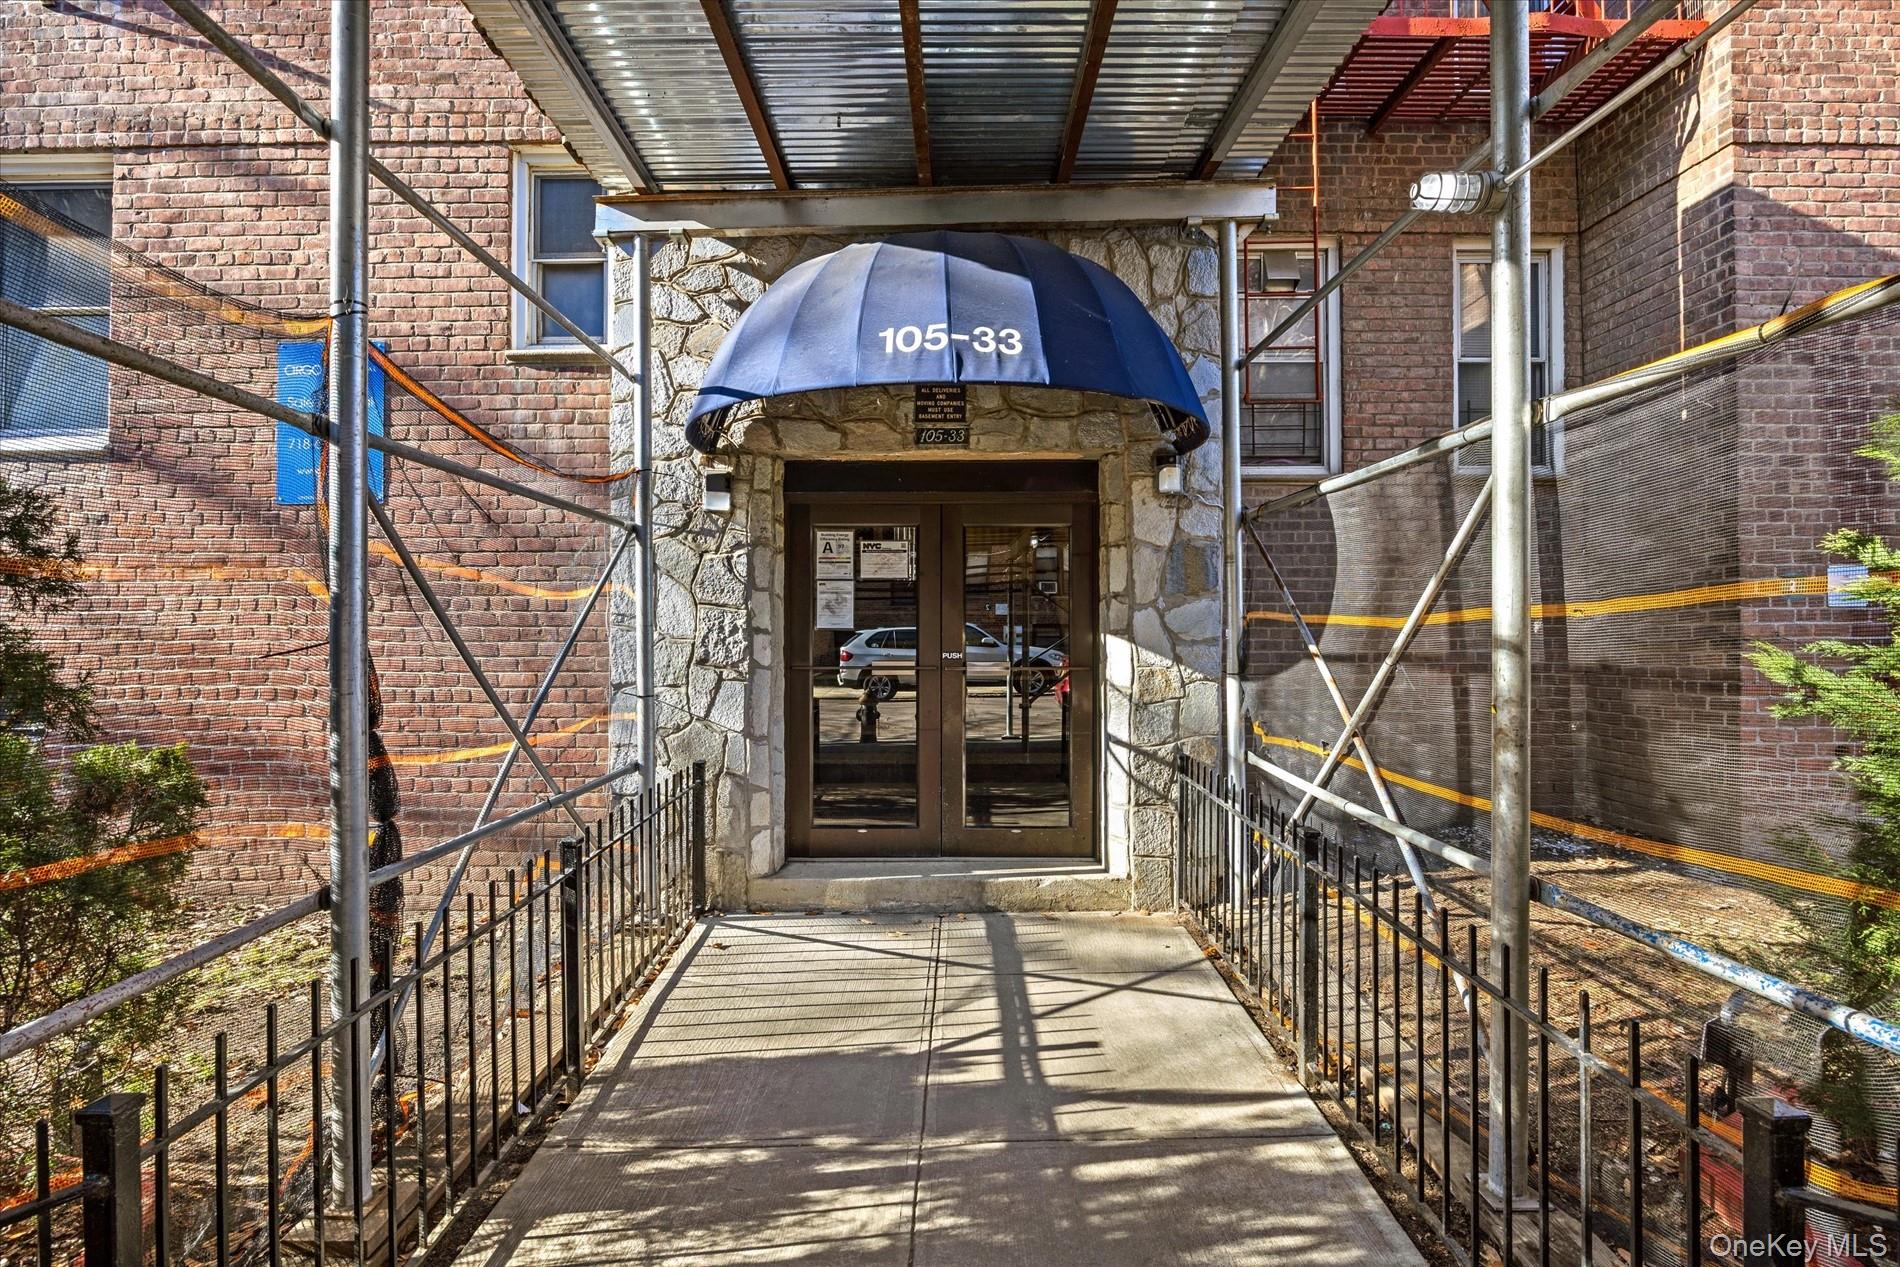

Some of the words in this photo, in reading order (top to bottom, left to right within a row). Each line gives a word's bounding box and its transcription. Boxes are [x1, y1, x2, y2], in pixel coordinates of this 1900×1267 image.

[879, 323, 1023, 355] 105-33
[920, 429, 965, 443] 105-33
[822, 541, 834, 554] A
[862, 542, 882, 550] NYC
